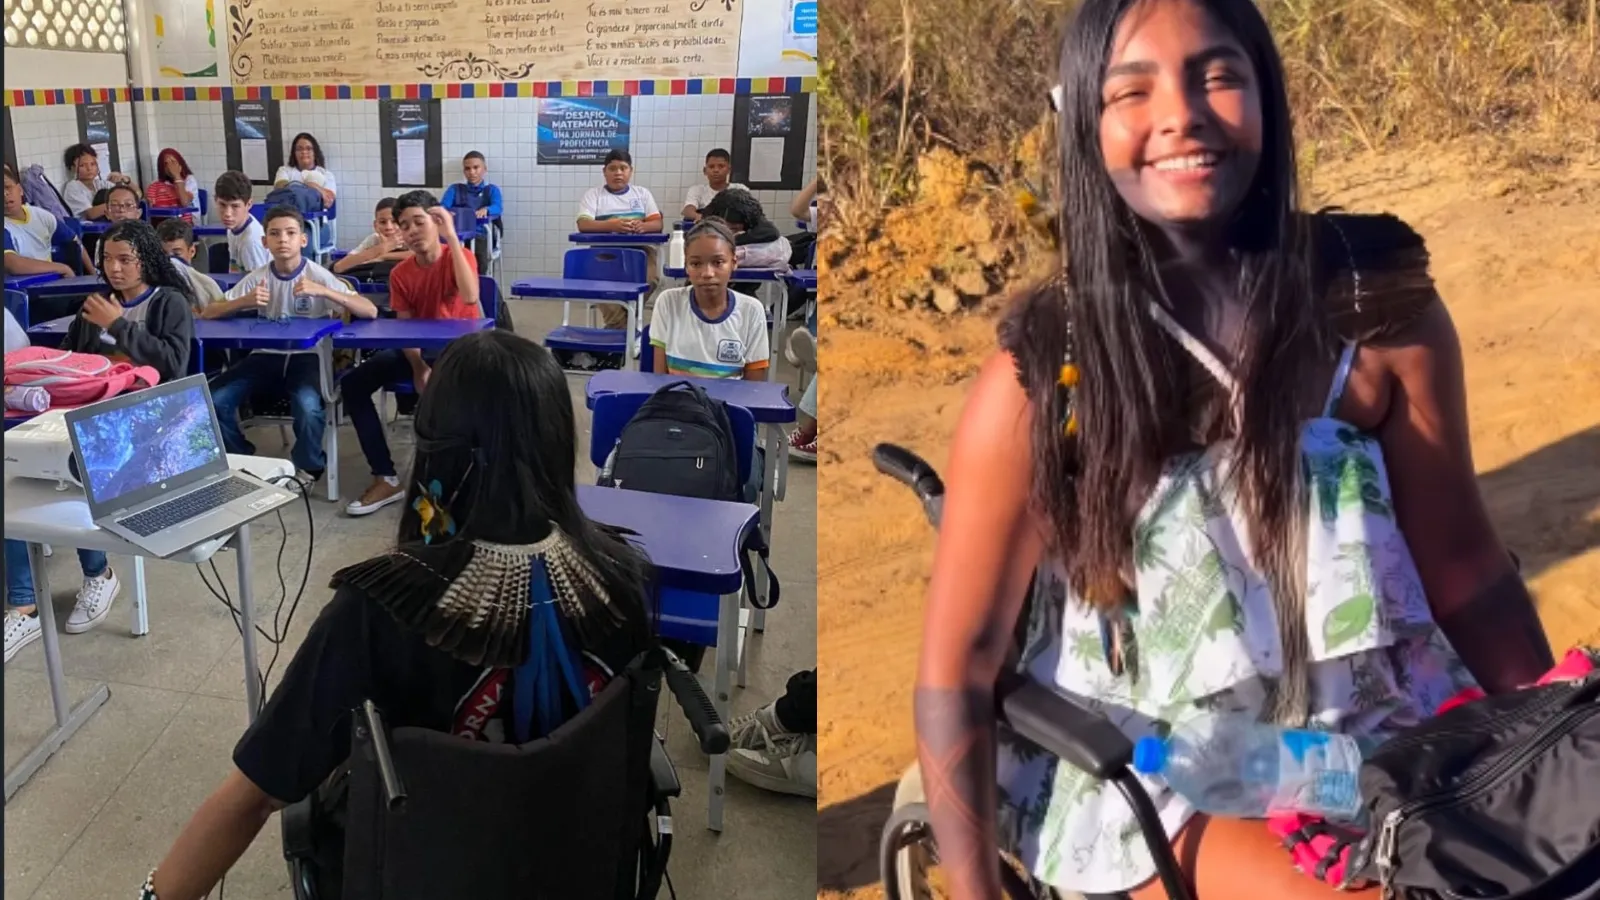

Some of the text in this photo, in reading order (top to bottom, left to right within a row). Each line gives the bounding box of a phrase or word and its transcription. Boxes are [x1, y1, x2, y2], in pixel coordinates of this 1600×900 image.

[587, 3, 597, 17] Tu
[597, 23, 629, 38] grandeza
[634, 19, 697, 34] proporcionalmente
[586, 39, 593, 50] E
[587, 53, 602, 66] Você
[565, 111, 606, 120] DESAFIO
[552, 119, 619, 129] MATEMÁTICA:
[553, 130, 617, 139] UMA JORNADA DE
[560, 138, 610, 148] PROFICIÊNCIA
